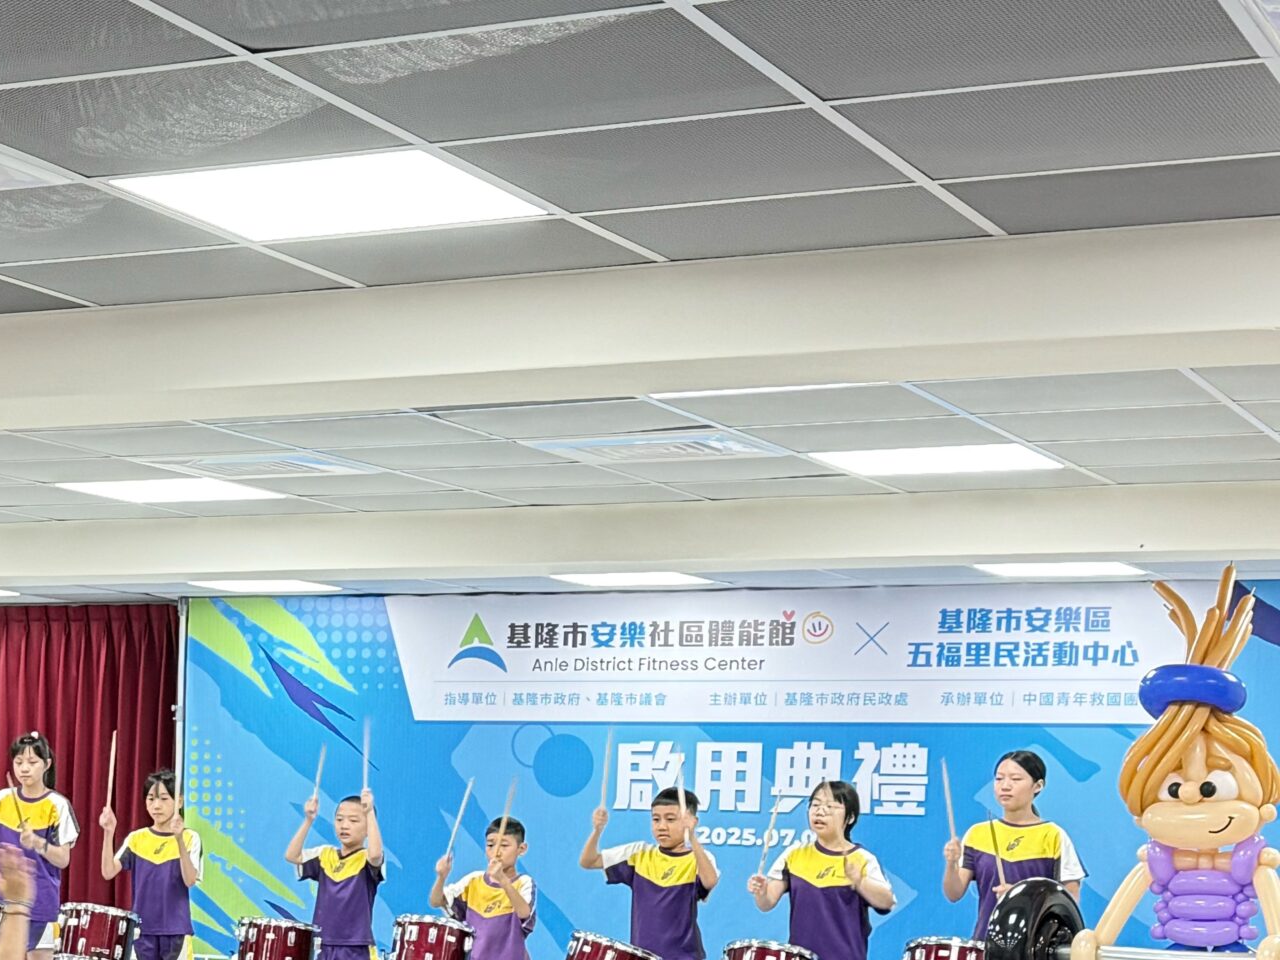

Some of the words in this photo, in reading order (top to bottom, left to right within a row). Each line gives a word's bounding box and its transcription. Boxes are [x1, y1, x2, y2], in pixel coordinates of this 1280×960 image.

[937, 606, 1113, 634] 基隆市安樂區
[506, 618, 795, 650] 基隆市安樂社區體能館
[906, 640, 1140, 668] 五福里民活動中心
[531, 657, 569, 672] Anle
[573, 657, 633, 672] District
[638, 656, 699, 672] Fitness
[704, 656, 766, 671] Center
[444, 692, 497, 706] 指導單位
[709, 692, 768, 706] 主辦單位
[784, 692, 909, 706] 基隆市政府民政處
[940, 691, 1004, 707] 承辦單位
